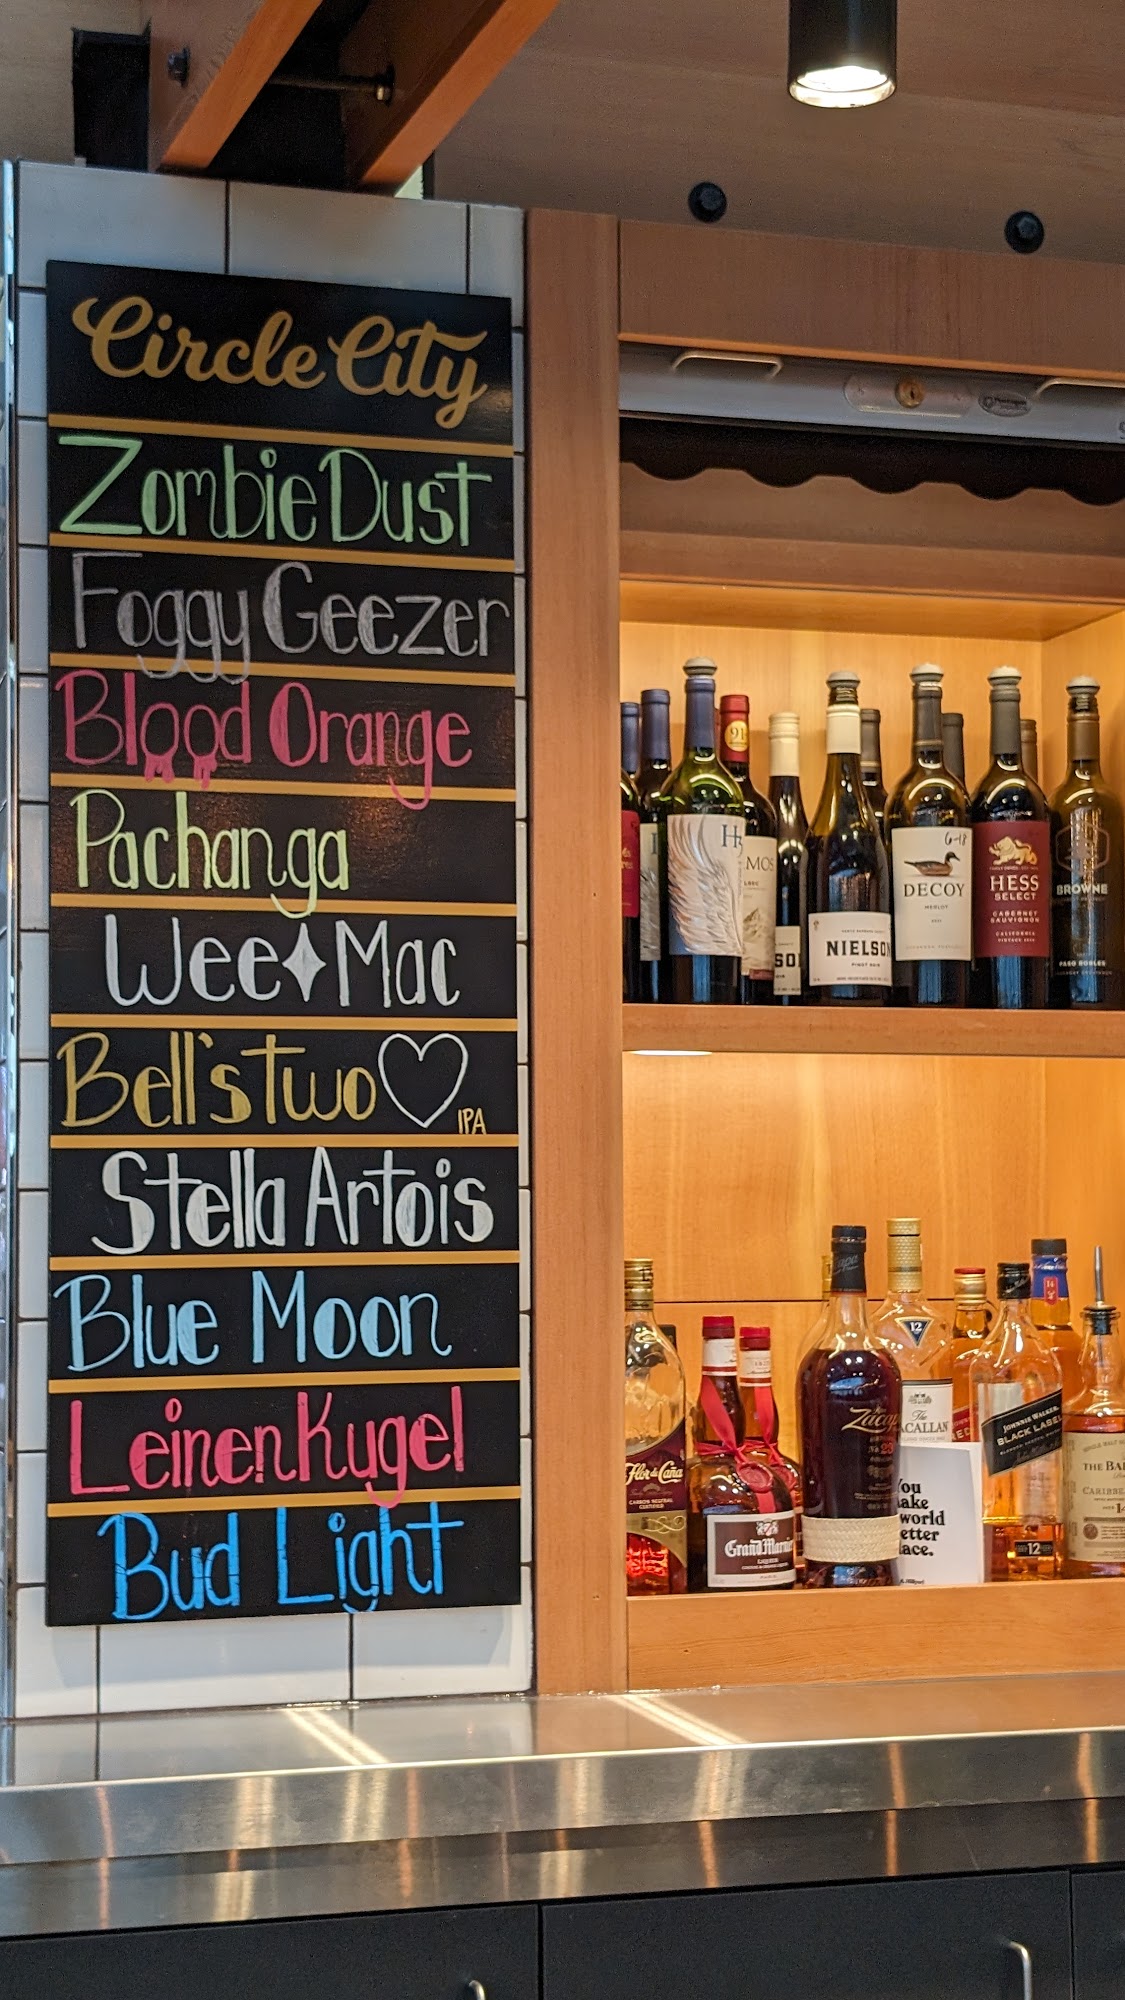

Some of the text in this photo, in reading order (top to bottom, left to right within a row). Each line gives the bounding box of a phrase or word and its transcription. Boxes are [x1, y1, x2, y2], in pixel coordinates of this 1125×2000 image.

[72, 296, 489, 429] Circle City
[58, 435, 493, 547] Zombie Dust
[72, 552, 511, 685] Foggy Geezer
[55, 669, 473, 810] Blood Orange
[70, 788, 351, 919] Pachanga
[745, 856, 775, 873] MOS
[903, 882, 965, 898] DECOY
[990, 874, 1039, 892] HESS
[1056, 883, 1108, 896] BROWNE
[994, 892, 1037, 901] SELECT
[826, 940, 891, 957] NIELSON
[105, 914, 461, 1009] Wee Mac
[57, 1031, 487, 1136] Bell's two IPA
[91, 1146, 495, 1255] Stella Artois
[53, 1270, 453, 1373] Blue Moon
[909, 1321, 923, 1332] 12
[841, 1406, 898, 1434] Zacap
[911, 1409, 928, 1421] The
[900, 1421, 949, 1434] ACALLAN
[997, 1426, 1034, 1446] BLACK
[1033, 1414, 1062, 1433] LABEL
[625, 1462, 651, 1486] Flor
[1083, 1462, 1104, 1472] THE
[897, 1494, 930, 1510] ake
[900, 1510, 946, 1527] world
[899, 1526, 940, 1542] etter
[724, 1538, 762, 1558] Grand
[1027, 1542, 1041, 1555] 12
[97, 1501, 465, 1621] Bud Light
